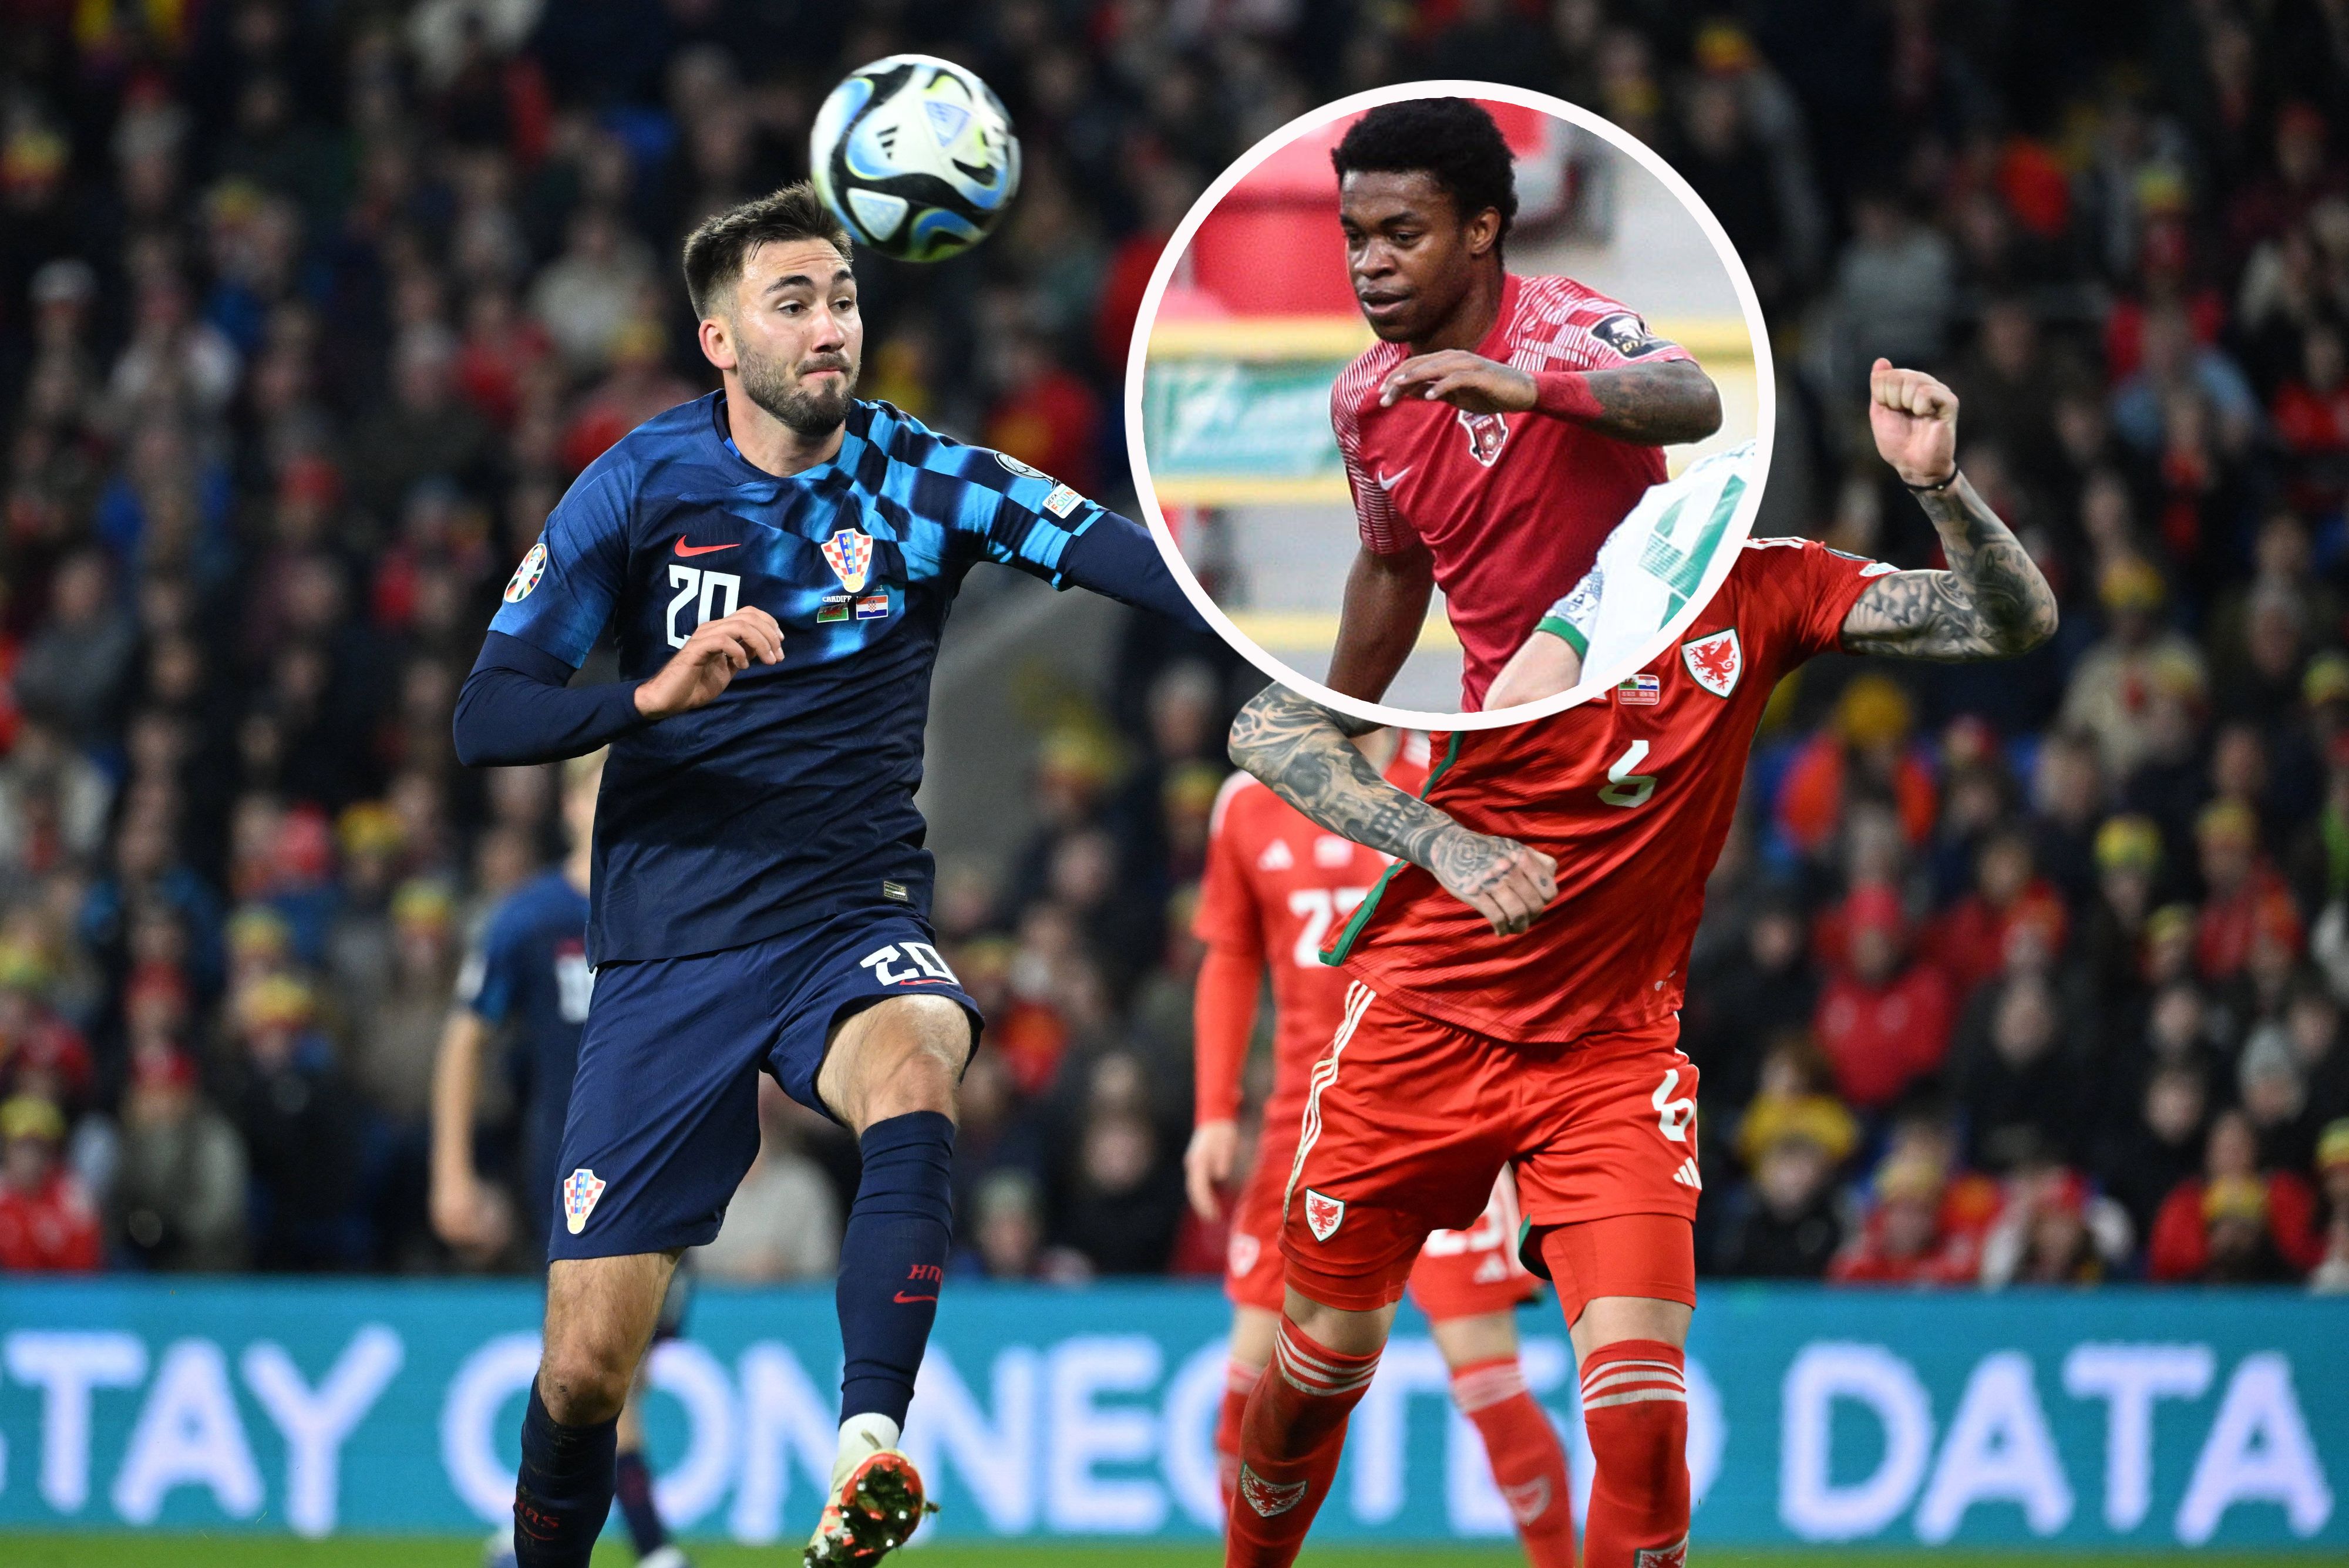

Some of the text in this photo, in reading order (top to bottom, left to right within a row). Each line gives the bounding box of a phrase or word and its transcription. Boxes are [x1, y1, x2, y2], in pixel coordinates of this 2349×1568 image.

[842, 536, 854, 568] HNS
[667, 564, 741, 650] 20
[822, 595, 852, 603] CARDIFF
[1597, 739, 1658, 809] 6
[859, 942, 960, 987] 20
[1651, 1069, 1695, 1142] 6
[576, 1176, 586, 1208] HNS
[907, 1264, 944, 1283] HN
[0, 1321, 405, 1540] TAY
[1779, 1338, 2334, 1546] DATA
